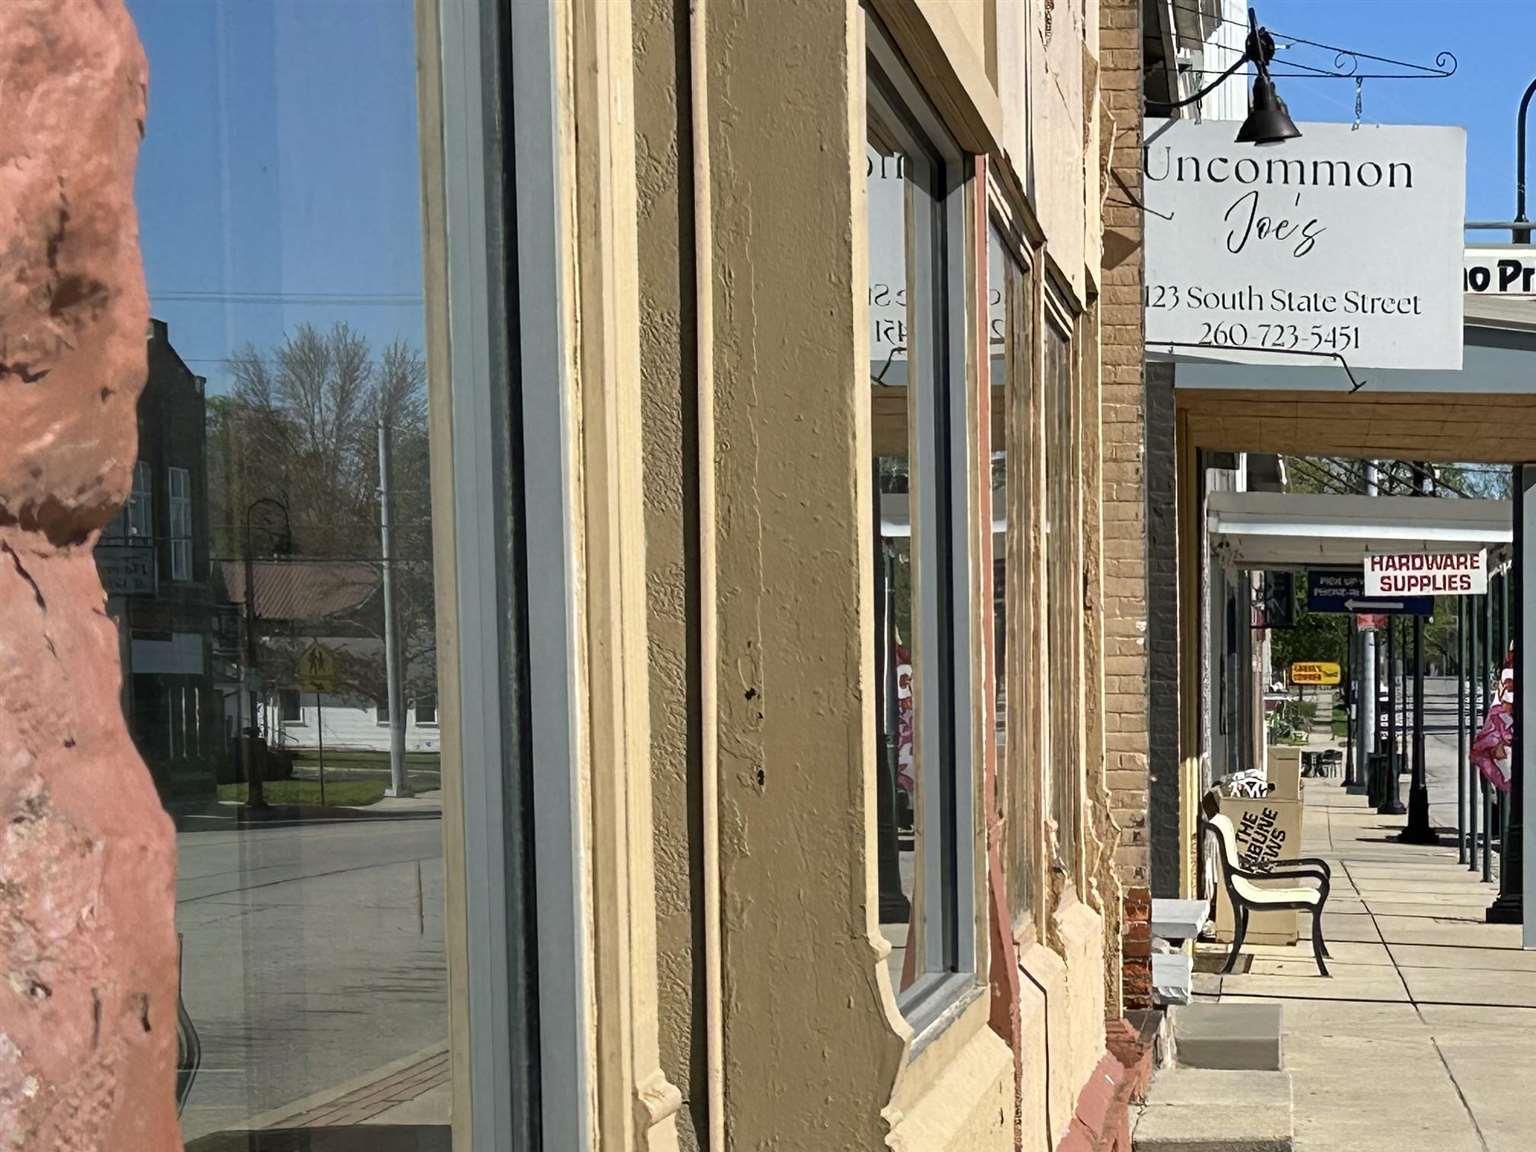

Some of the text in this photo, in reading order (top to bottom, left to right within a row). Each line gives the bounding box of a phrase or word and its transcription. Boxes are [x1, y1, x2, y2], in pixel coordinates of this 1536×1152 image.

[1143, 145, 1413, 189] Uncommon
[1223, 190, 1328, 258] Joe's
[1145, 284, 1422, 316] 123 South State Street
[1199, 321, 1360, 352] 260-723-5451
[1371, 553, 1480, 571] HARDWARE
[1380, 574, 1471, 592] SUPPLIES
[1236, 811, 1258, 844] THE
